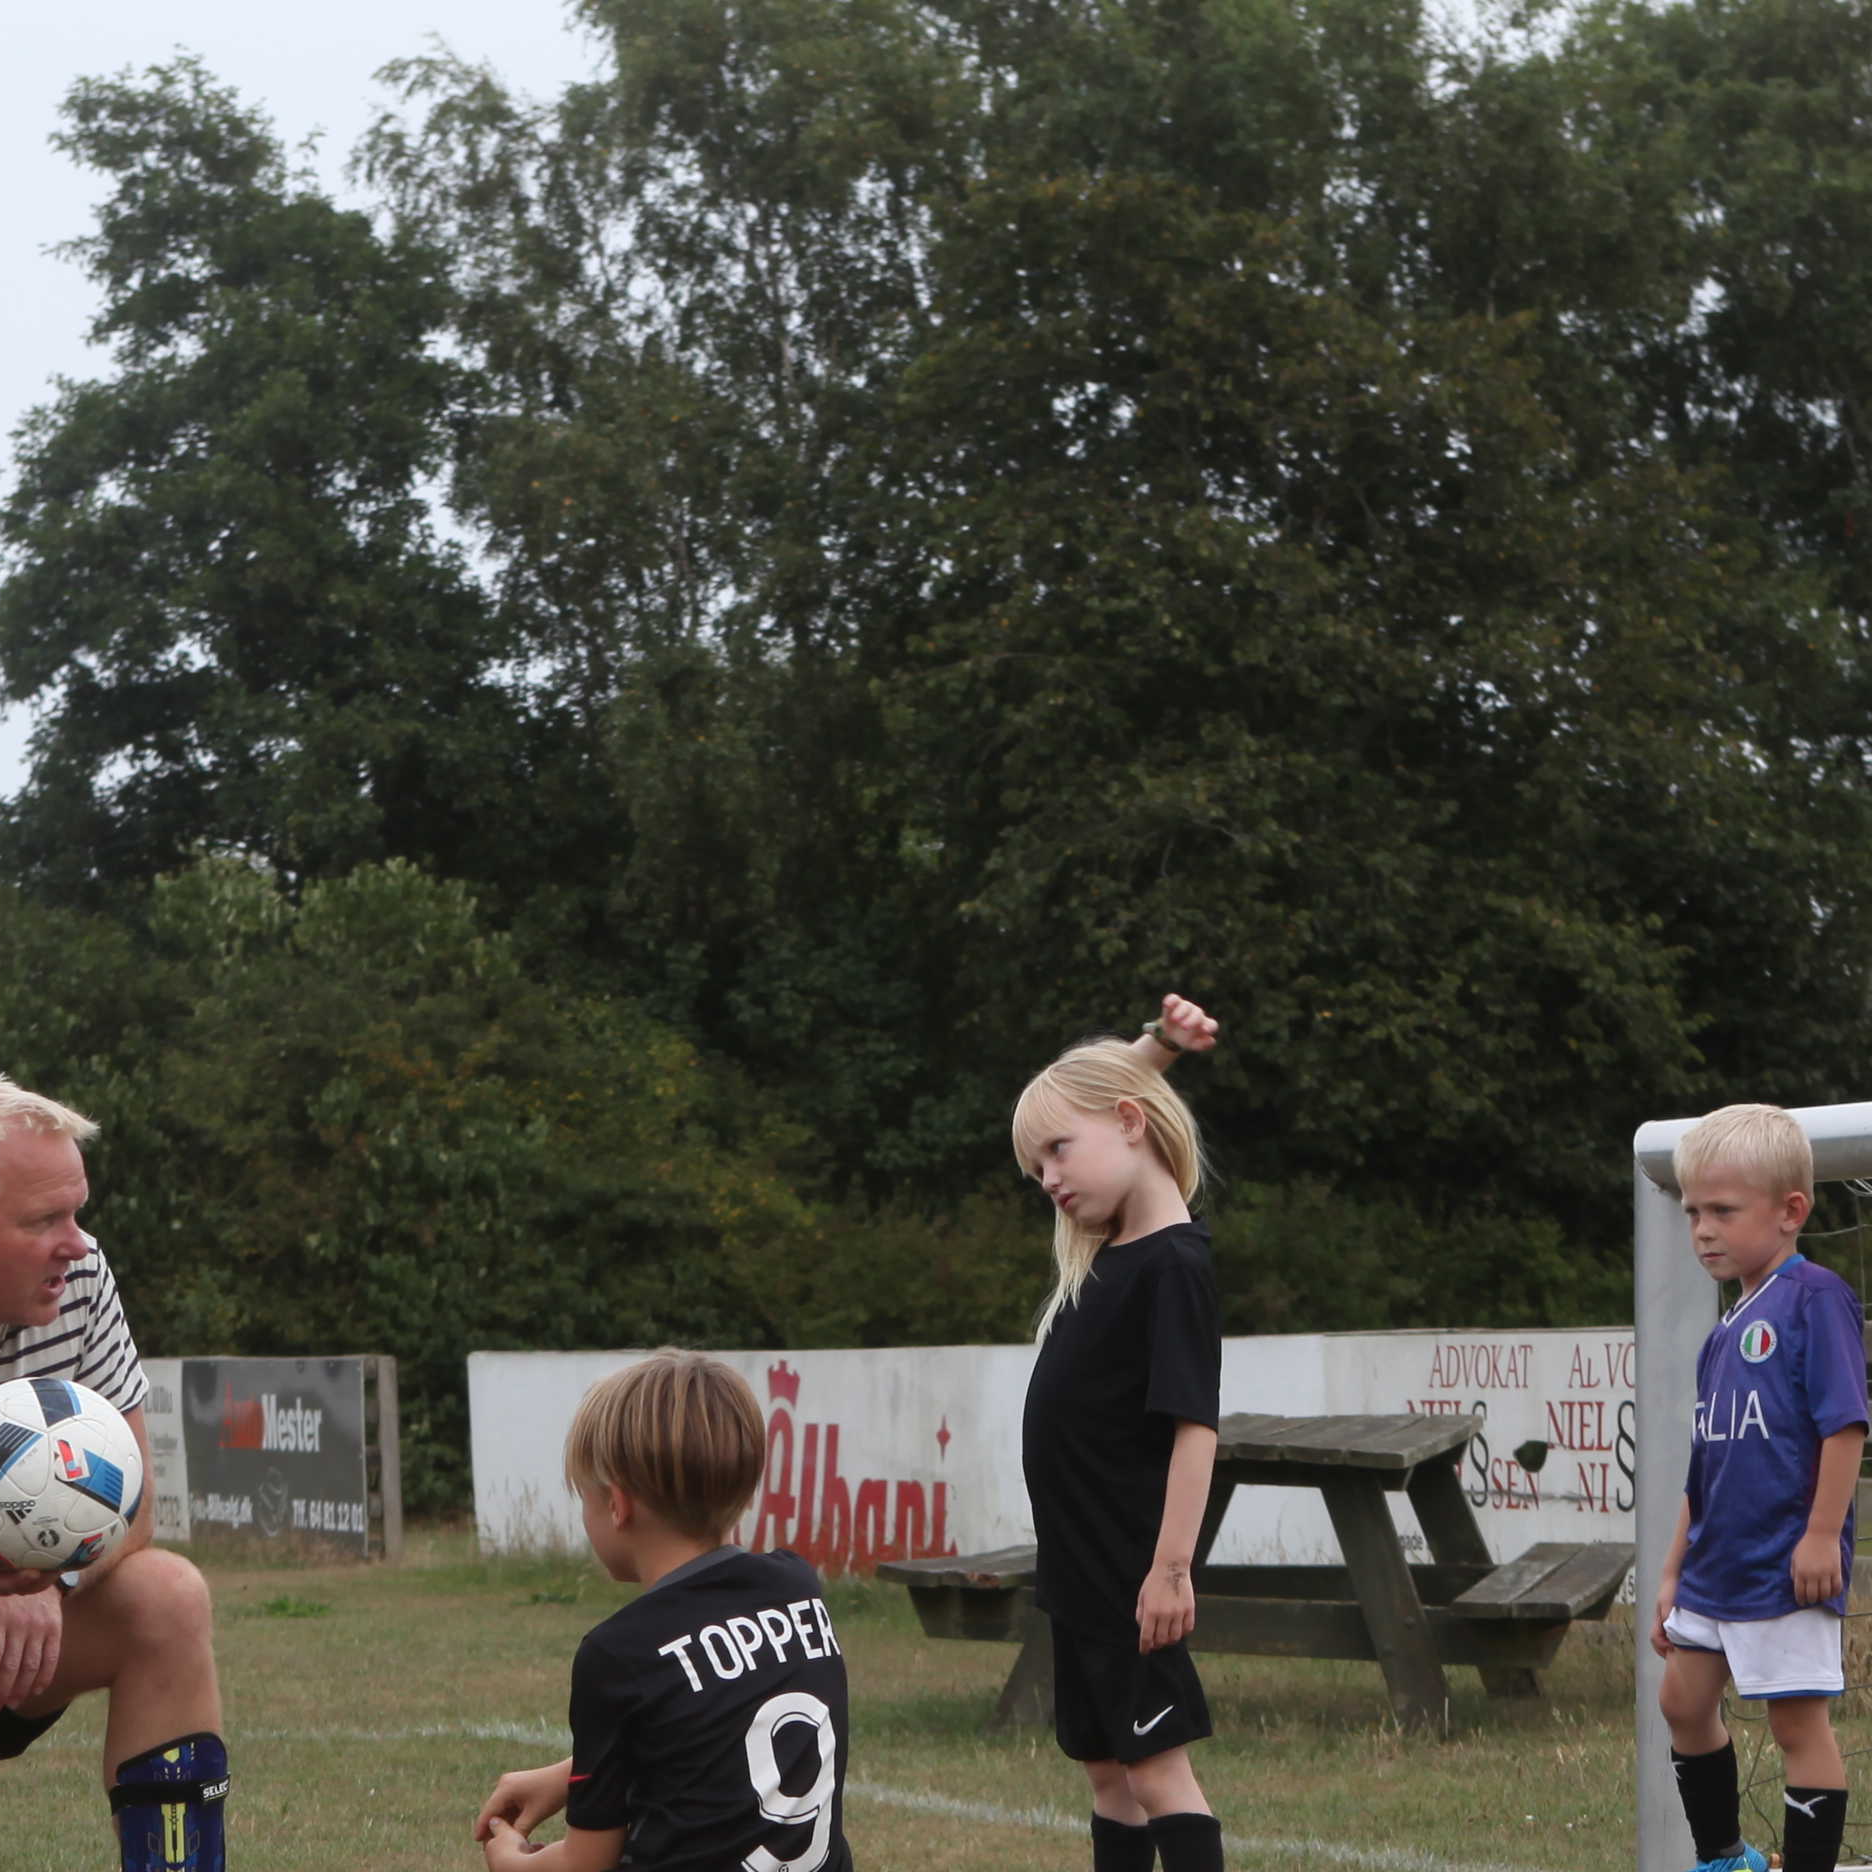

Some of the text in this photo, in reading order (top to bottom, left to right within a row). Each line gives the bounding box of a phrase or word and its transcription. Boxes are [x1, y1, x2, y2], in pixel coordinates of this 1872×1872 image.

[1428, 1344, 1532, 1389] ADVOKAT
[734, 1407, 959, 1580] Albani
[337, 1502, 350, 1532] 12
[202, 1779, 229, 1798] SELEC
